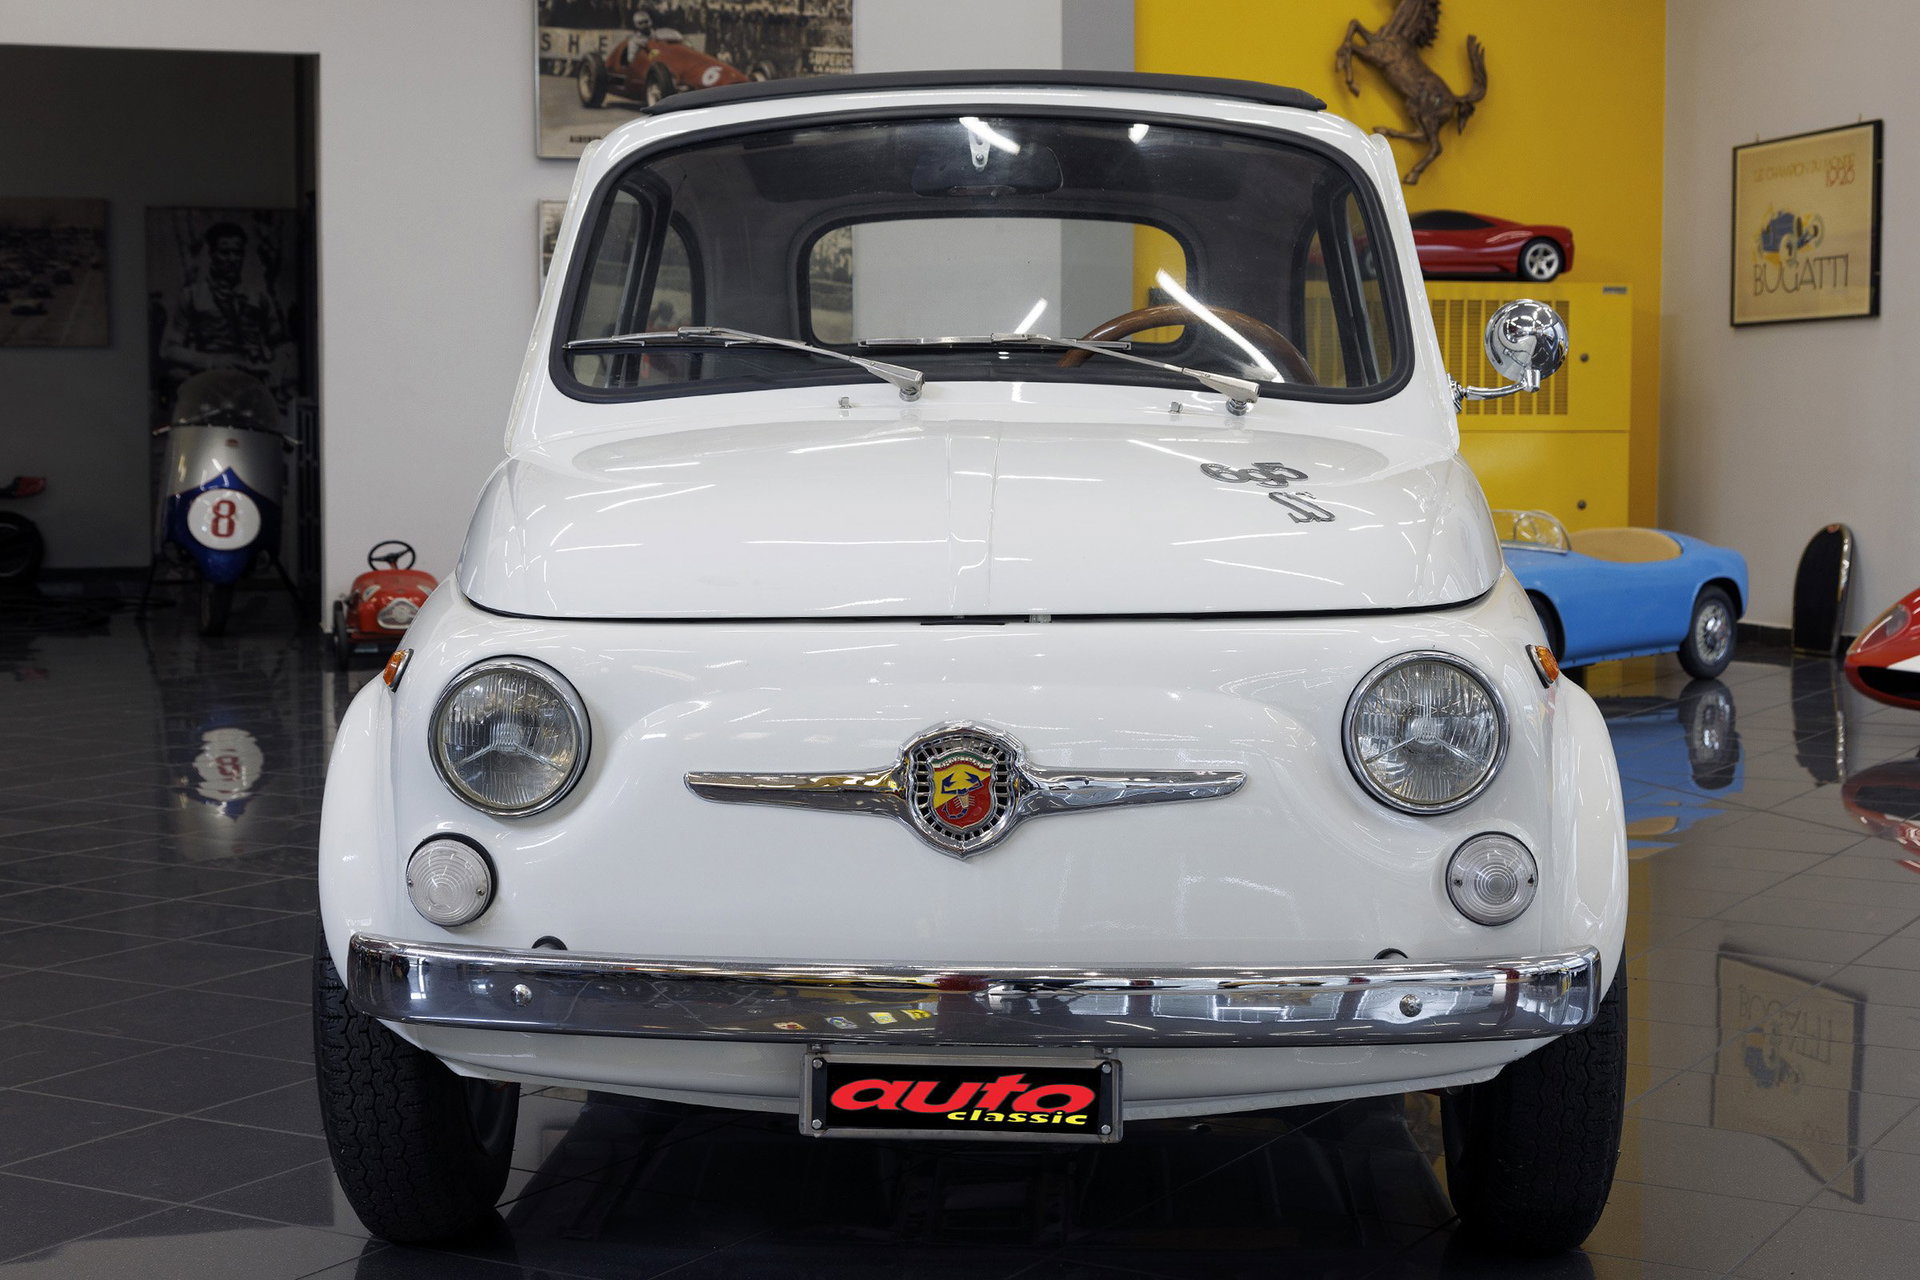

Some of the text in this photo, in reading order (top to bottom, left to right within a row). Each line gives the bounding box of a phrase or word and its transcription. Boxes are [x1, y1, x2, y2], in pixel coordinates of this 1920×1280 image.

[1753, 254, 1849, 296] BUGATTI
[210, 499, 237, 539] 8
[830, 1073, 1096, 1114] auto
[946, 1109, 1088, 1126] classic
